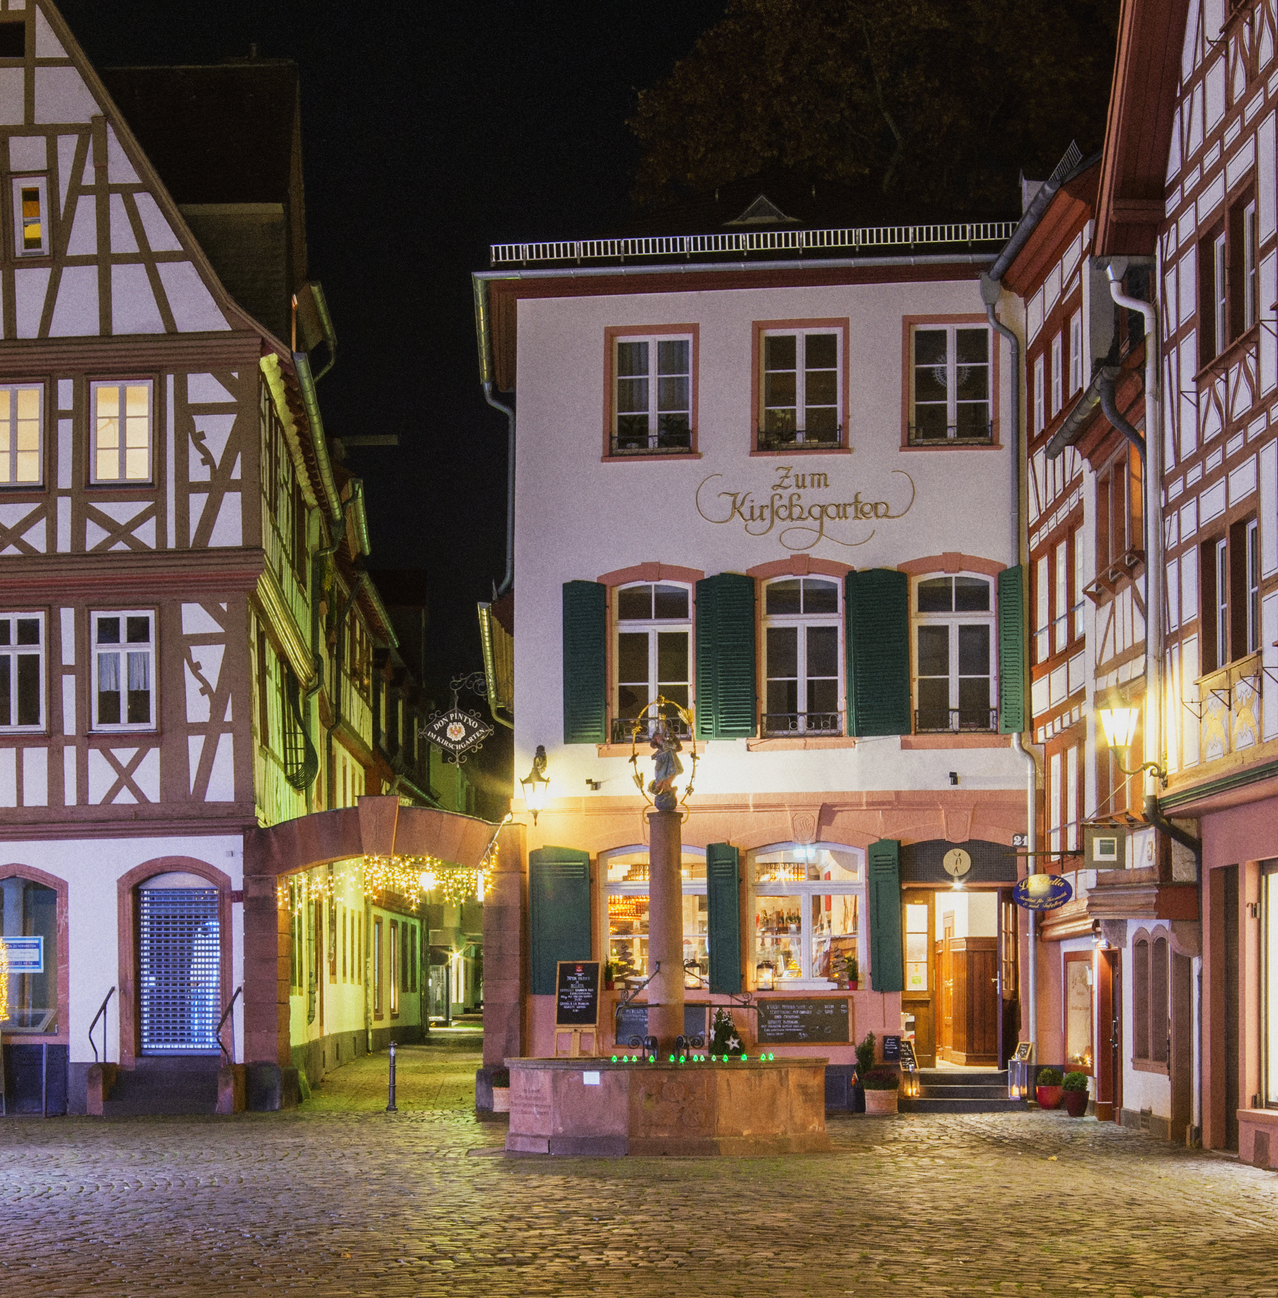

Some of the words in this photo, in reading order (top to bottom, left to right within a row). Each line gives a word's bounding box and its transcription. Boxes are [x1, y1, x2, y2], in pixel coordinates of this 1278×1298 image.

[771, 465, 831, 490] Zum
[433, 716, 449, 731] DON
[449, 712, 478, 729] PINTXO
[427, 731, 437, 740] IM
[436, 728, 485, 750] KIRSCHGARTEN
